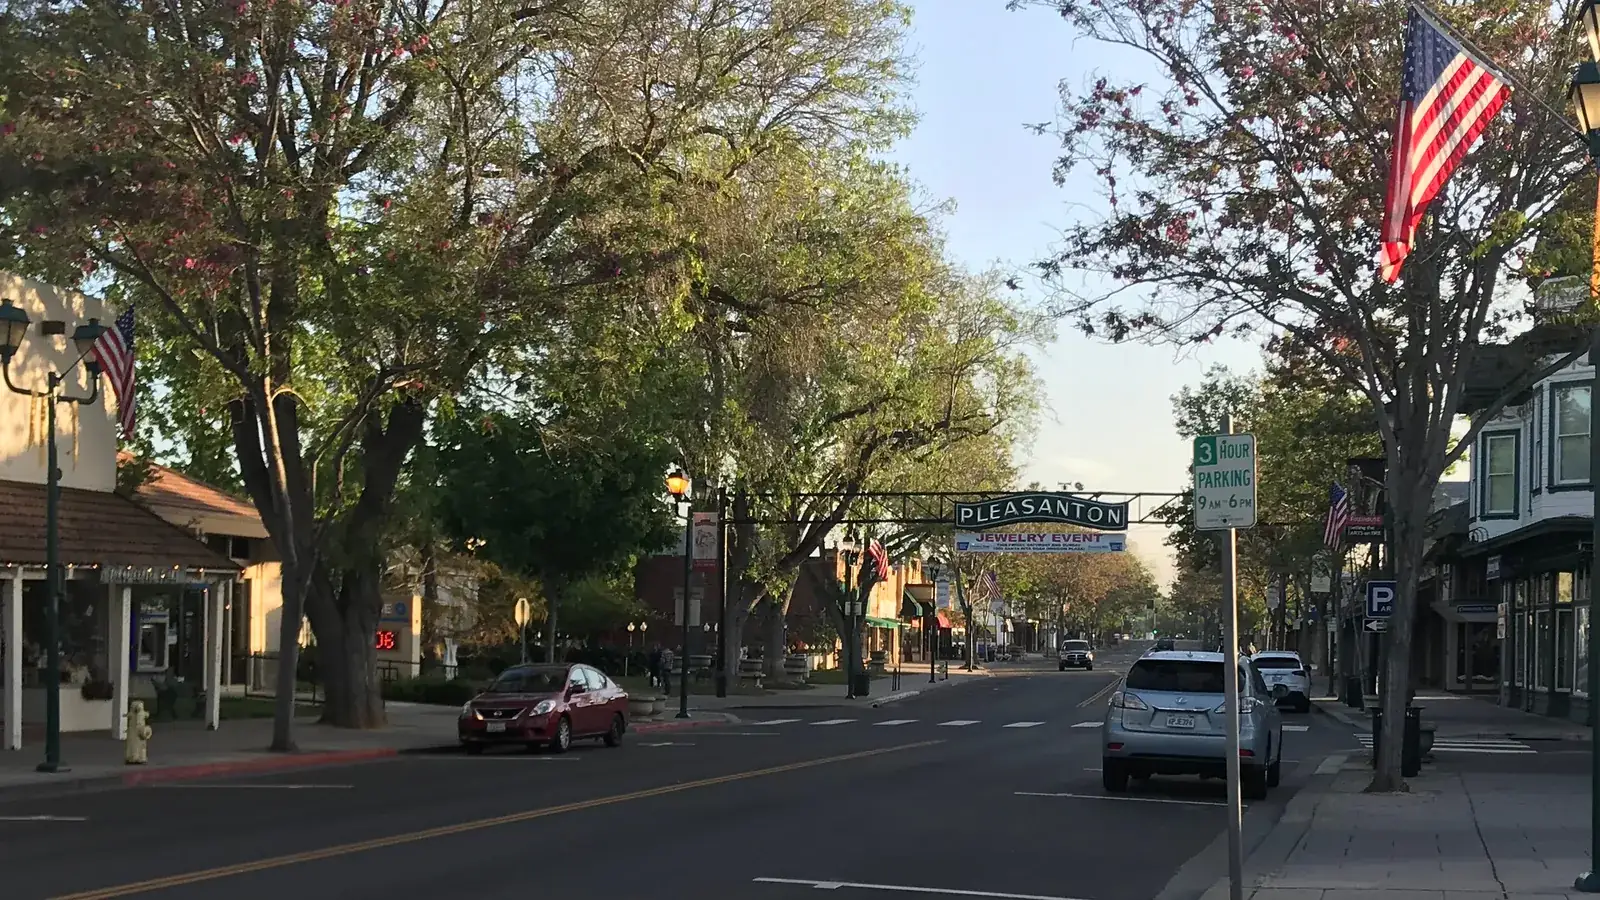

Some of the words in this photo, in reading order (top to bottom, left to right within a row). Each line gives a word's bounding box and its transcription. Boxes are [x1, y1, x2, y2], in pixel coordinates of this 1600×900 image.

[1199, 442, 1212, 463] 3
[1220, 443, 1249, 459] HOUR
[1198, 469, 1250, 488] PARKING
[960, 498, 1120, 524] PLEASANTON
[1198, 495, 1207, 510] 9
[1208, 500, 1221, 509] AM
[1229, 494, 1237, 508] 6
[1239, 499, 1252, 508] PM
[976, 533, 1047, 543] JEWELRY
[1051, 533, 1103, 543] EVENT
